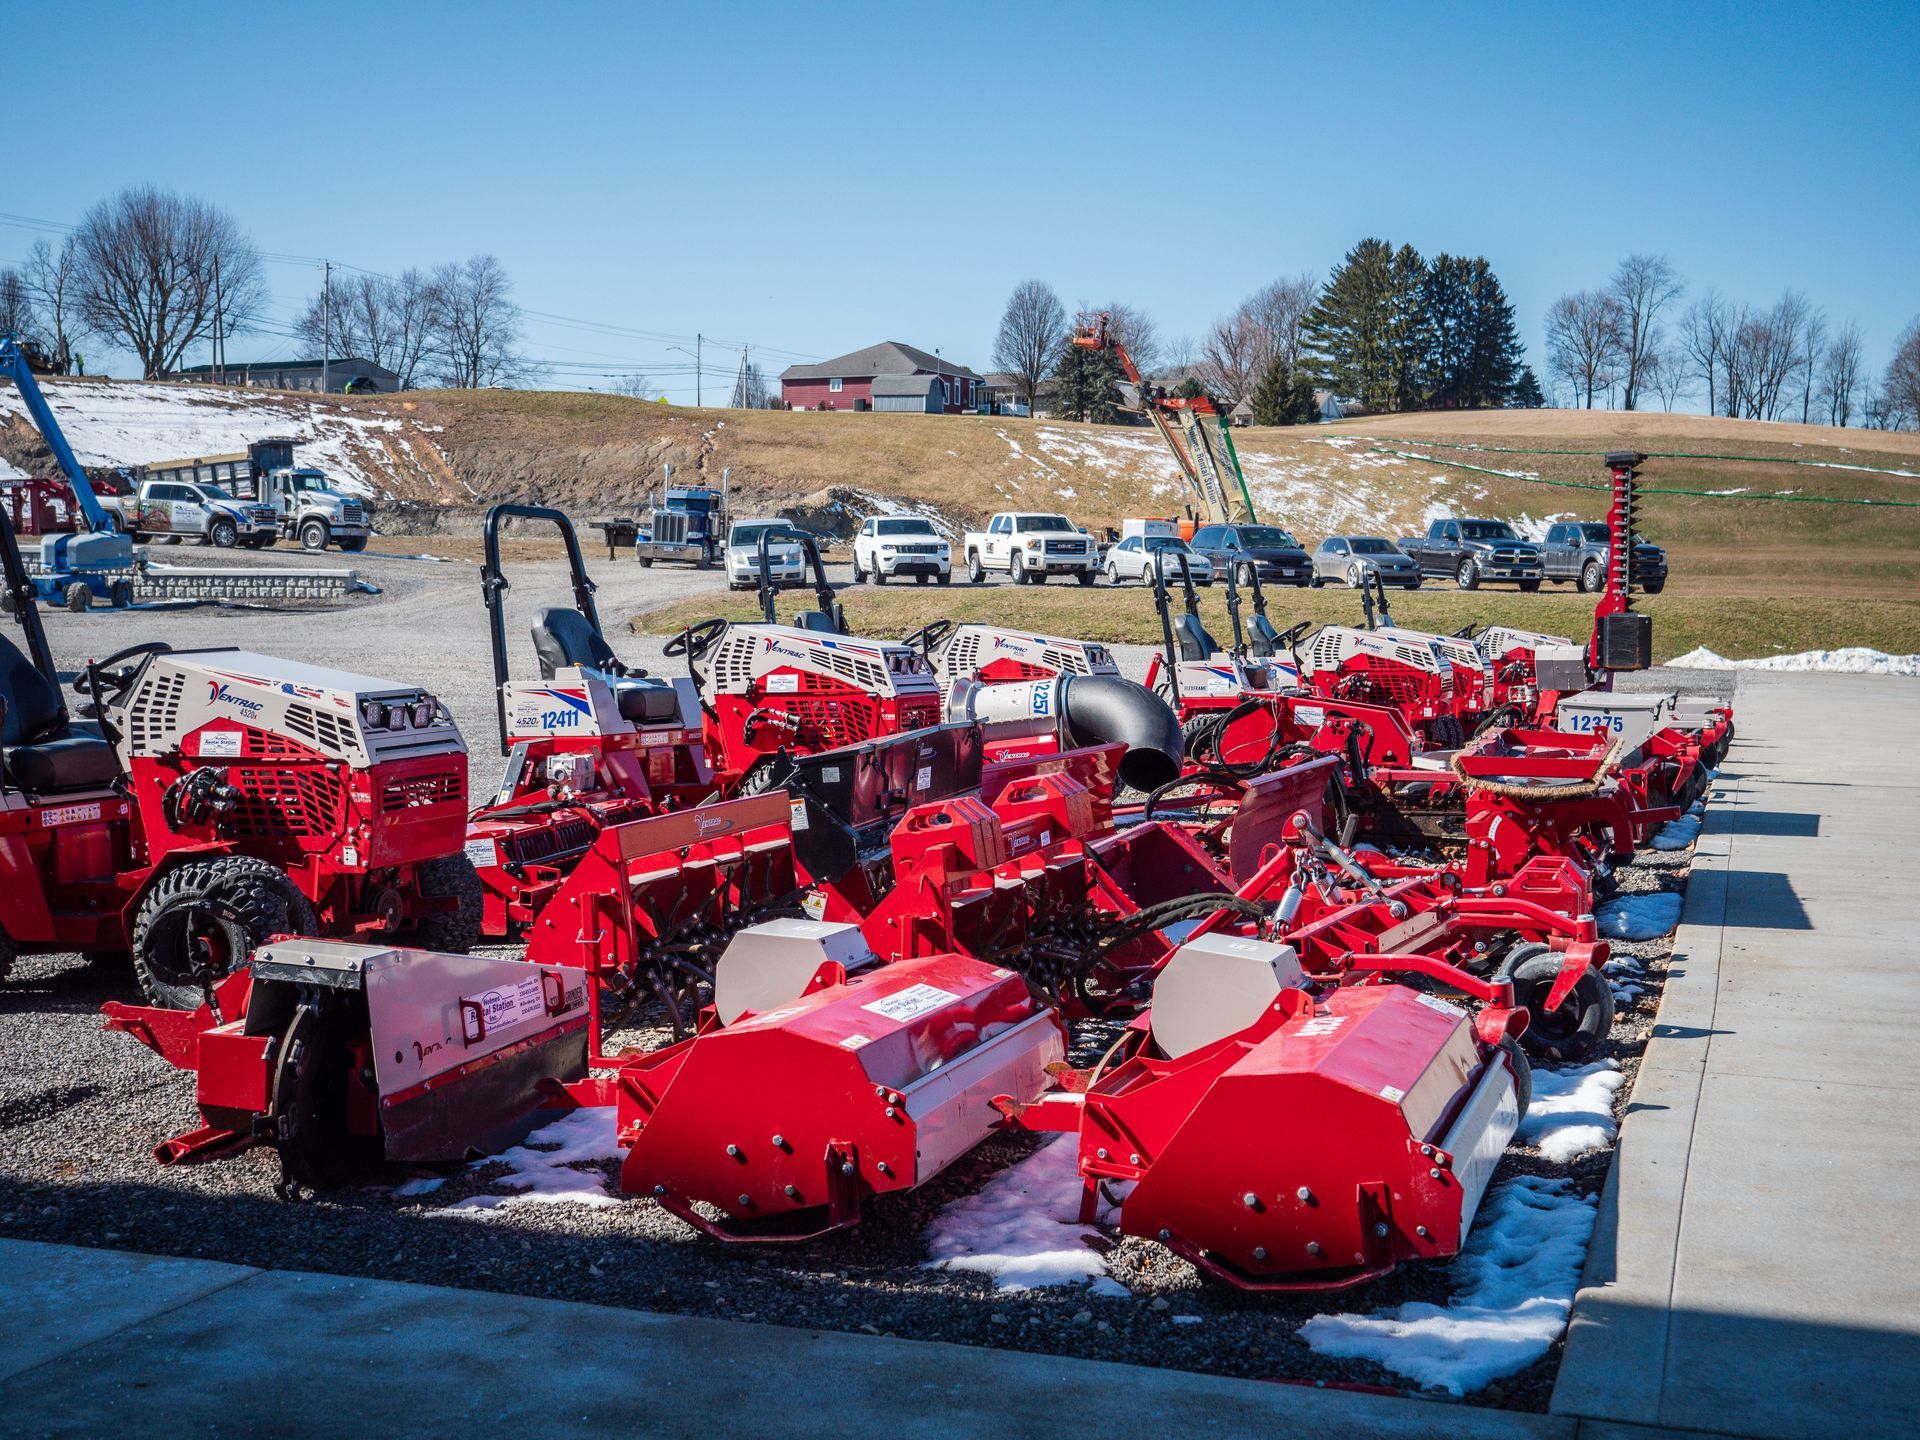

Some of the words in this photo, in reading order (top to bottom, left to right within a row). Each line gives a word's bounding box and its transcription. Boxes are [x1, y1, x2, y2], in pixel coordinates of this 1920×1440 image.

[1189, 425, 1200, 452] Holmes
[1197, 453, 1208, 477] Rental
[1204, 477, 1217, 504] Station
[763, 637, 805, 659] VENTRAC
[994, 637, 1028, 653] VENTRAC
[1353, 636, 1383, 650] VENTRAC
[206, 680, 263, 711] VENTRAC
[1033, 680, 1052, 715] 12257
[541, 709, 579, 729] 12411
[1571, 715, 1624, 733] 12375
[996, 749, 1030, 761] VENTRAC
[695, 813, 721, 836] VENTRAC
[483, 996, 501, 1006] Holmes
[492, 999, 514, 1013] Station
